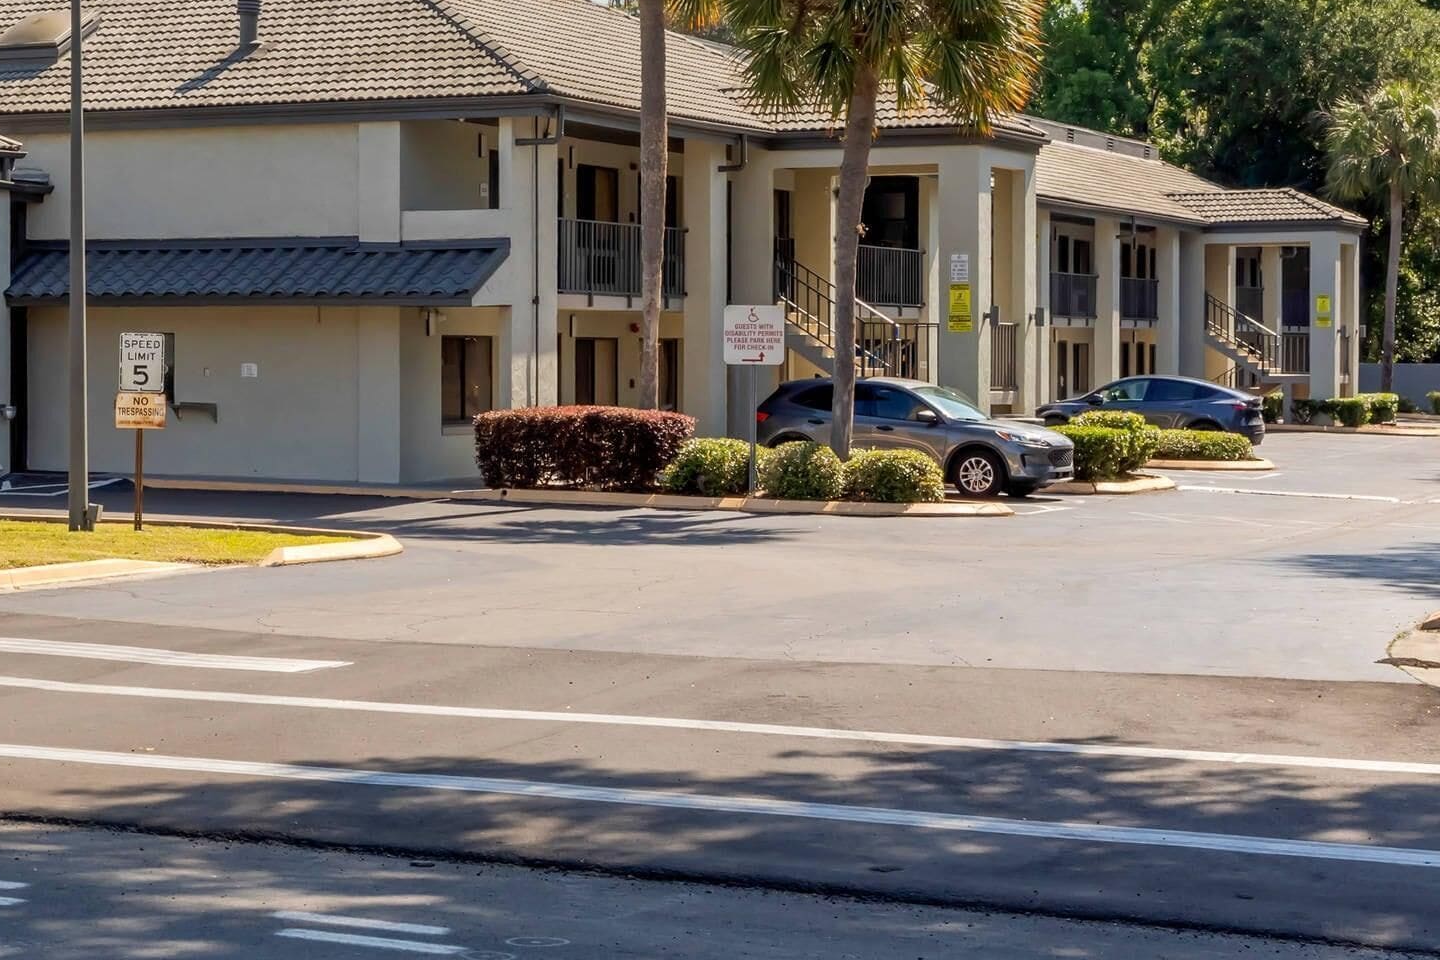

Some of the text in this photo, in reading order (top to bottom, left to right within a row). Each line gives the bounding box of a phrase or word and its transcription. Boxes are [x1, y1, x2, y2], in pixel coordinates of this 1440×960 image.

[124, 340, 160, 348] SPEED
[128, 352, 156, 360] LIMIT
[133, 365, 149, 385] 5
[133, 397, 149, 406] NO
[118, 407, 165, 416] TRESPASSING
